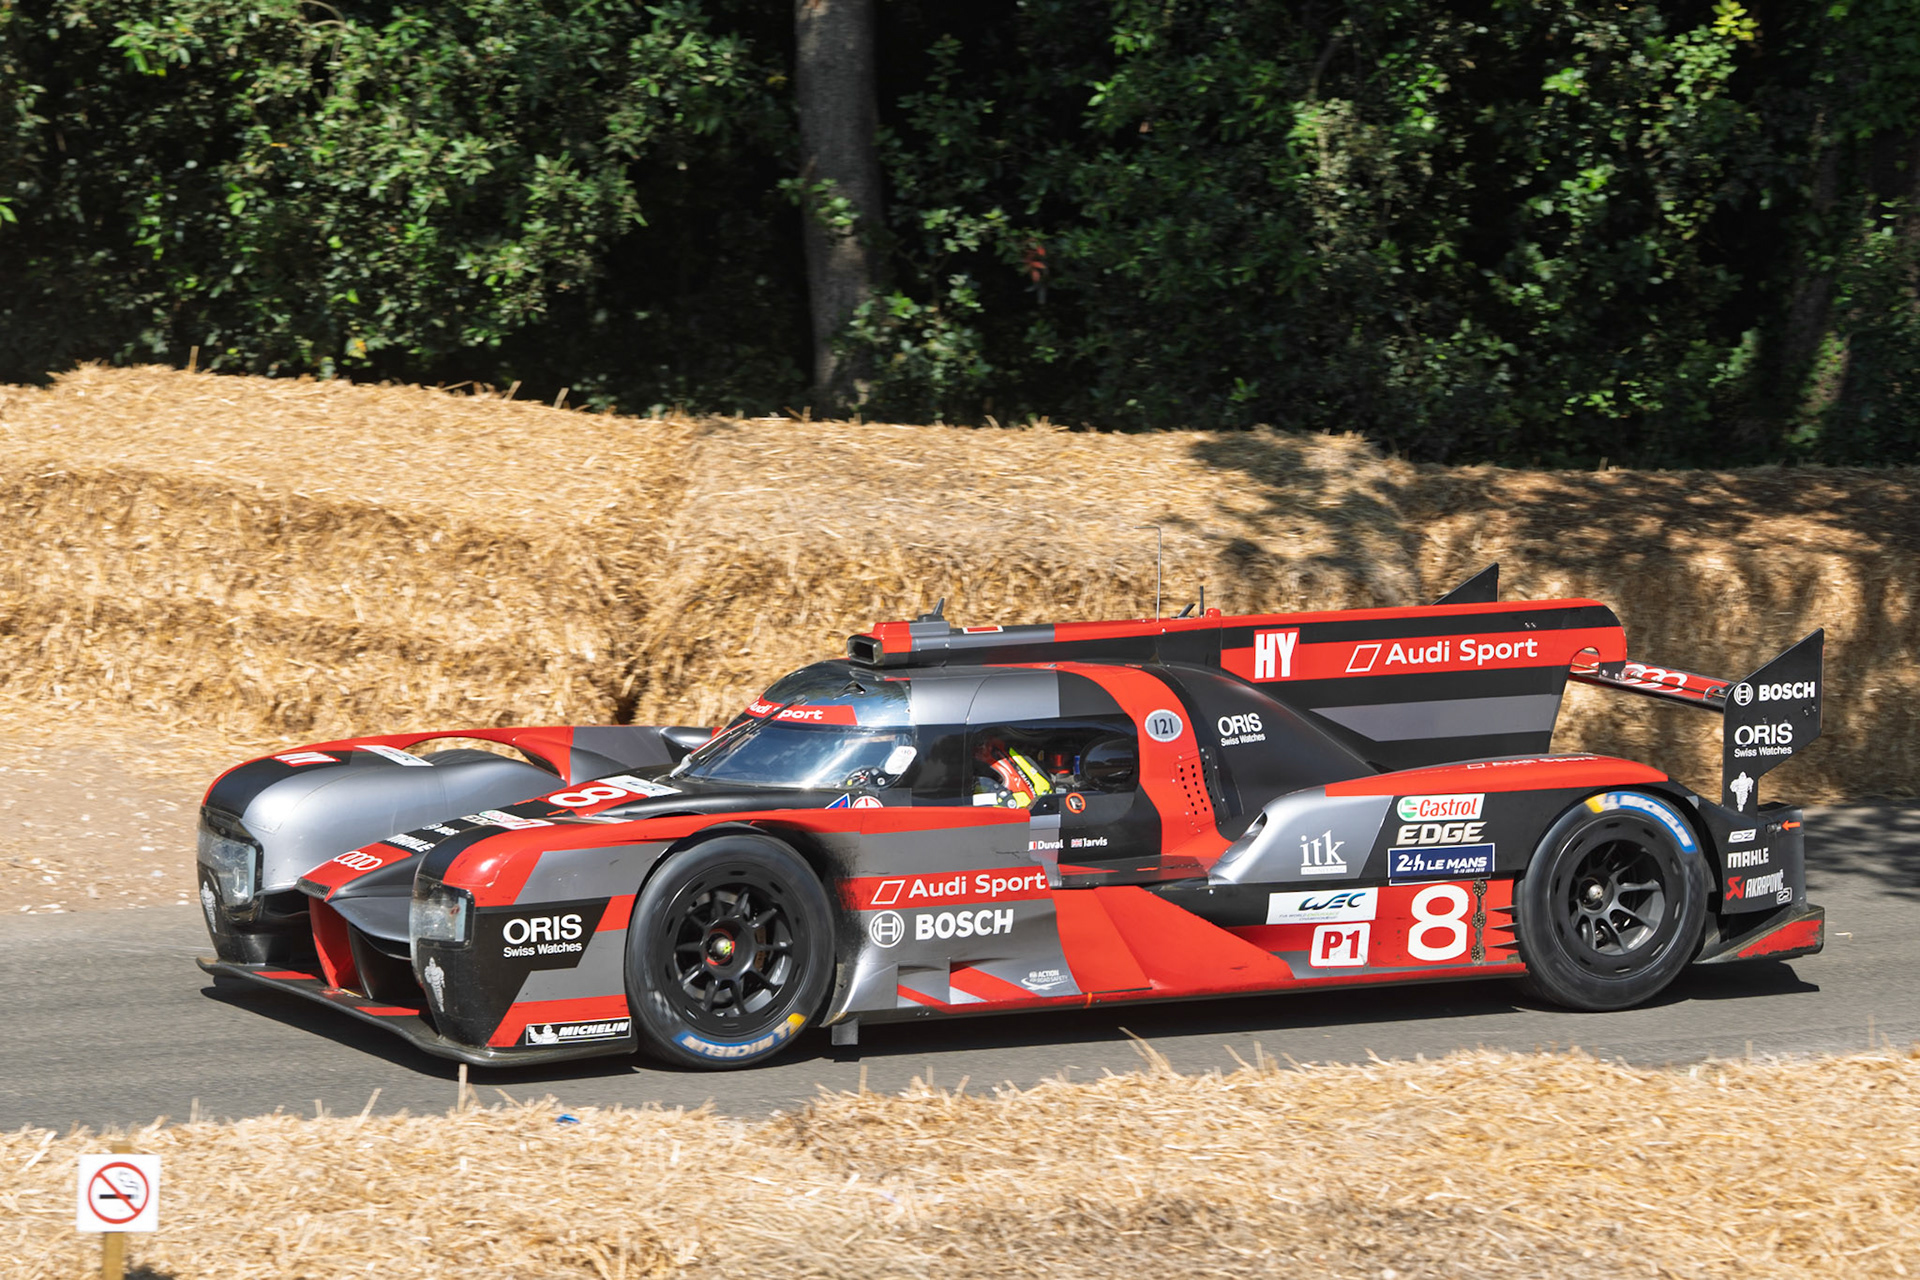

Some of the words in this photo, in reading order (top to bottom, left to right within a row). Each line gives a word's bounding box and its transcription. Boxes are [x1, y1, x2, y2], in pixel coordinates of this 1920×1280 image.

[1254, 632, 1298, 679] HY
[1385, 641, 1449, 665] Audi
[1459, 638, 1538, 666] Sport
[1758, 682, 1816, 701] BOSCH
[773, 706, 823, 720] port
[1154, 718, 1174, 735] 121
[1217, 712, 1263, 737] ORIS
[1734, 722, 1793, 746] ORIS
[1220, 737, 1240, 747] Swiss
[1239, 733, 1266, 744] Watches
[1734, 747, 1757, 758] Swiss
[1758, 745, 1792, 756] Watches
[548, 786, 628, 808] 8
[1419, 797, 1478, 817] Castrol
[1038, 839, 1063, 850] Duval
[1396, 821, 1488, 846] EDGE
[1300, 829, 1347, 867] itk
[1727, 847, 1769, 869] MAHLE
[1396, 853, 1425, 872] 24h
[1426, 859, 1445, 870] LE
[1446, 856, 1488, 869] MANS
[908, 876, 967, 899] Audi
[975, 872, 1046, 898] Sport
[1298, 892, 1366, 911] WEC
[502, 913, 583, 945] ORIS
[915, 908, 1014, 941] BOSCH
[1407, 884, 1469, 961] 8
[503, 945, 535, 958] Swiss
[537, 941, 582, 955] Watches
[1321, 930, 1360, 960] P1
[559, 1022, 629, 1037] MICHELIN
